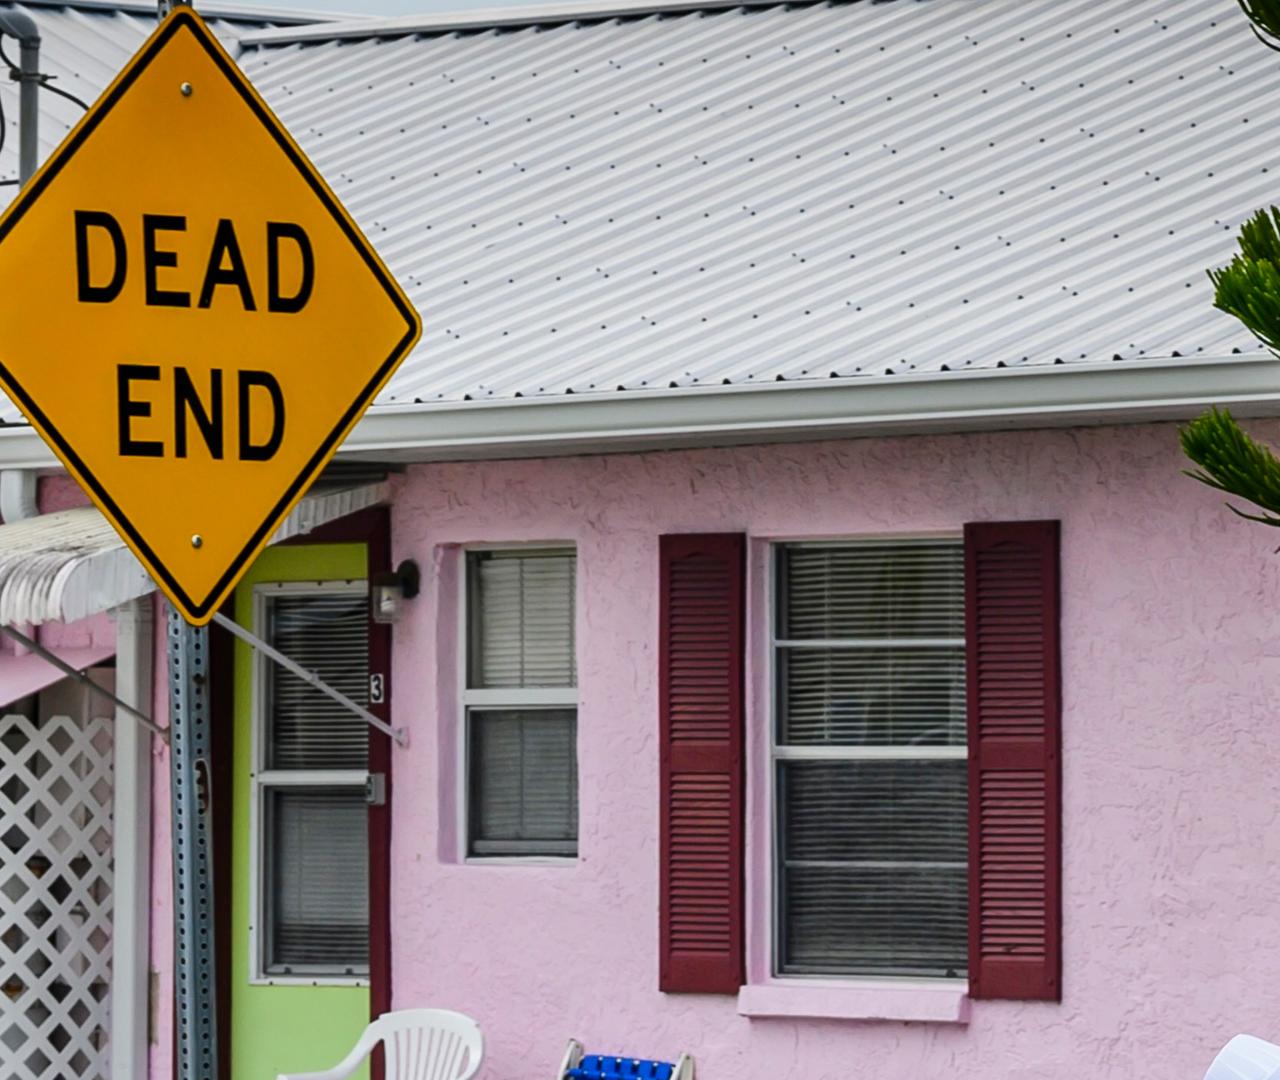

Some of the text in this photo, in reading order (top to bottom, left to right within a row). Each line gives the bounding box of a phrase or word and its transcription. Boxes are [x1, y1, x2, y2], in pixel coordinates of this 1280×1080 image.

[73, 210, 315, 314] DEAD
[116, 364, 286, 462] END
[372, 675, 382, 702] 3
